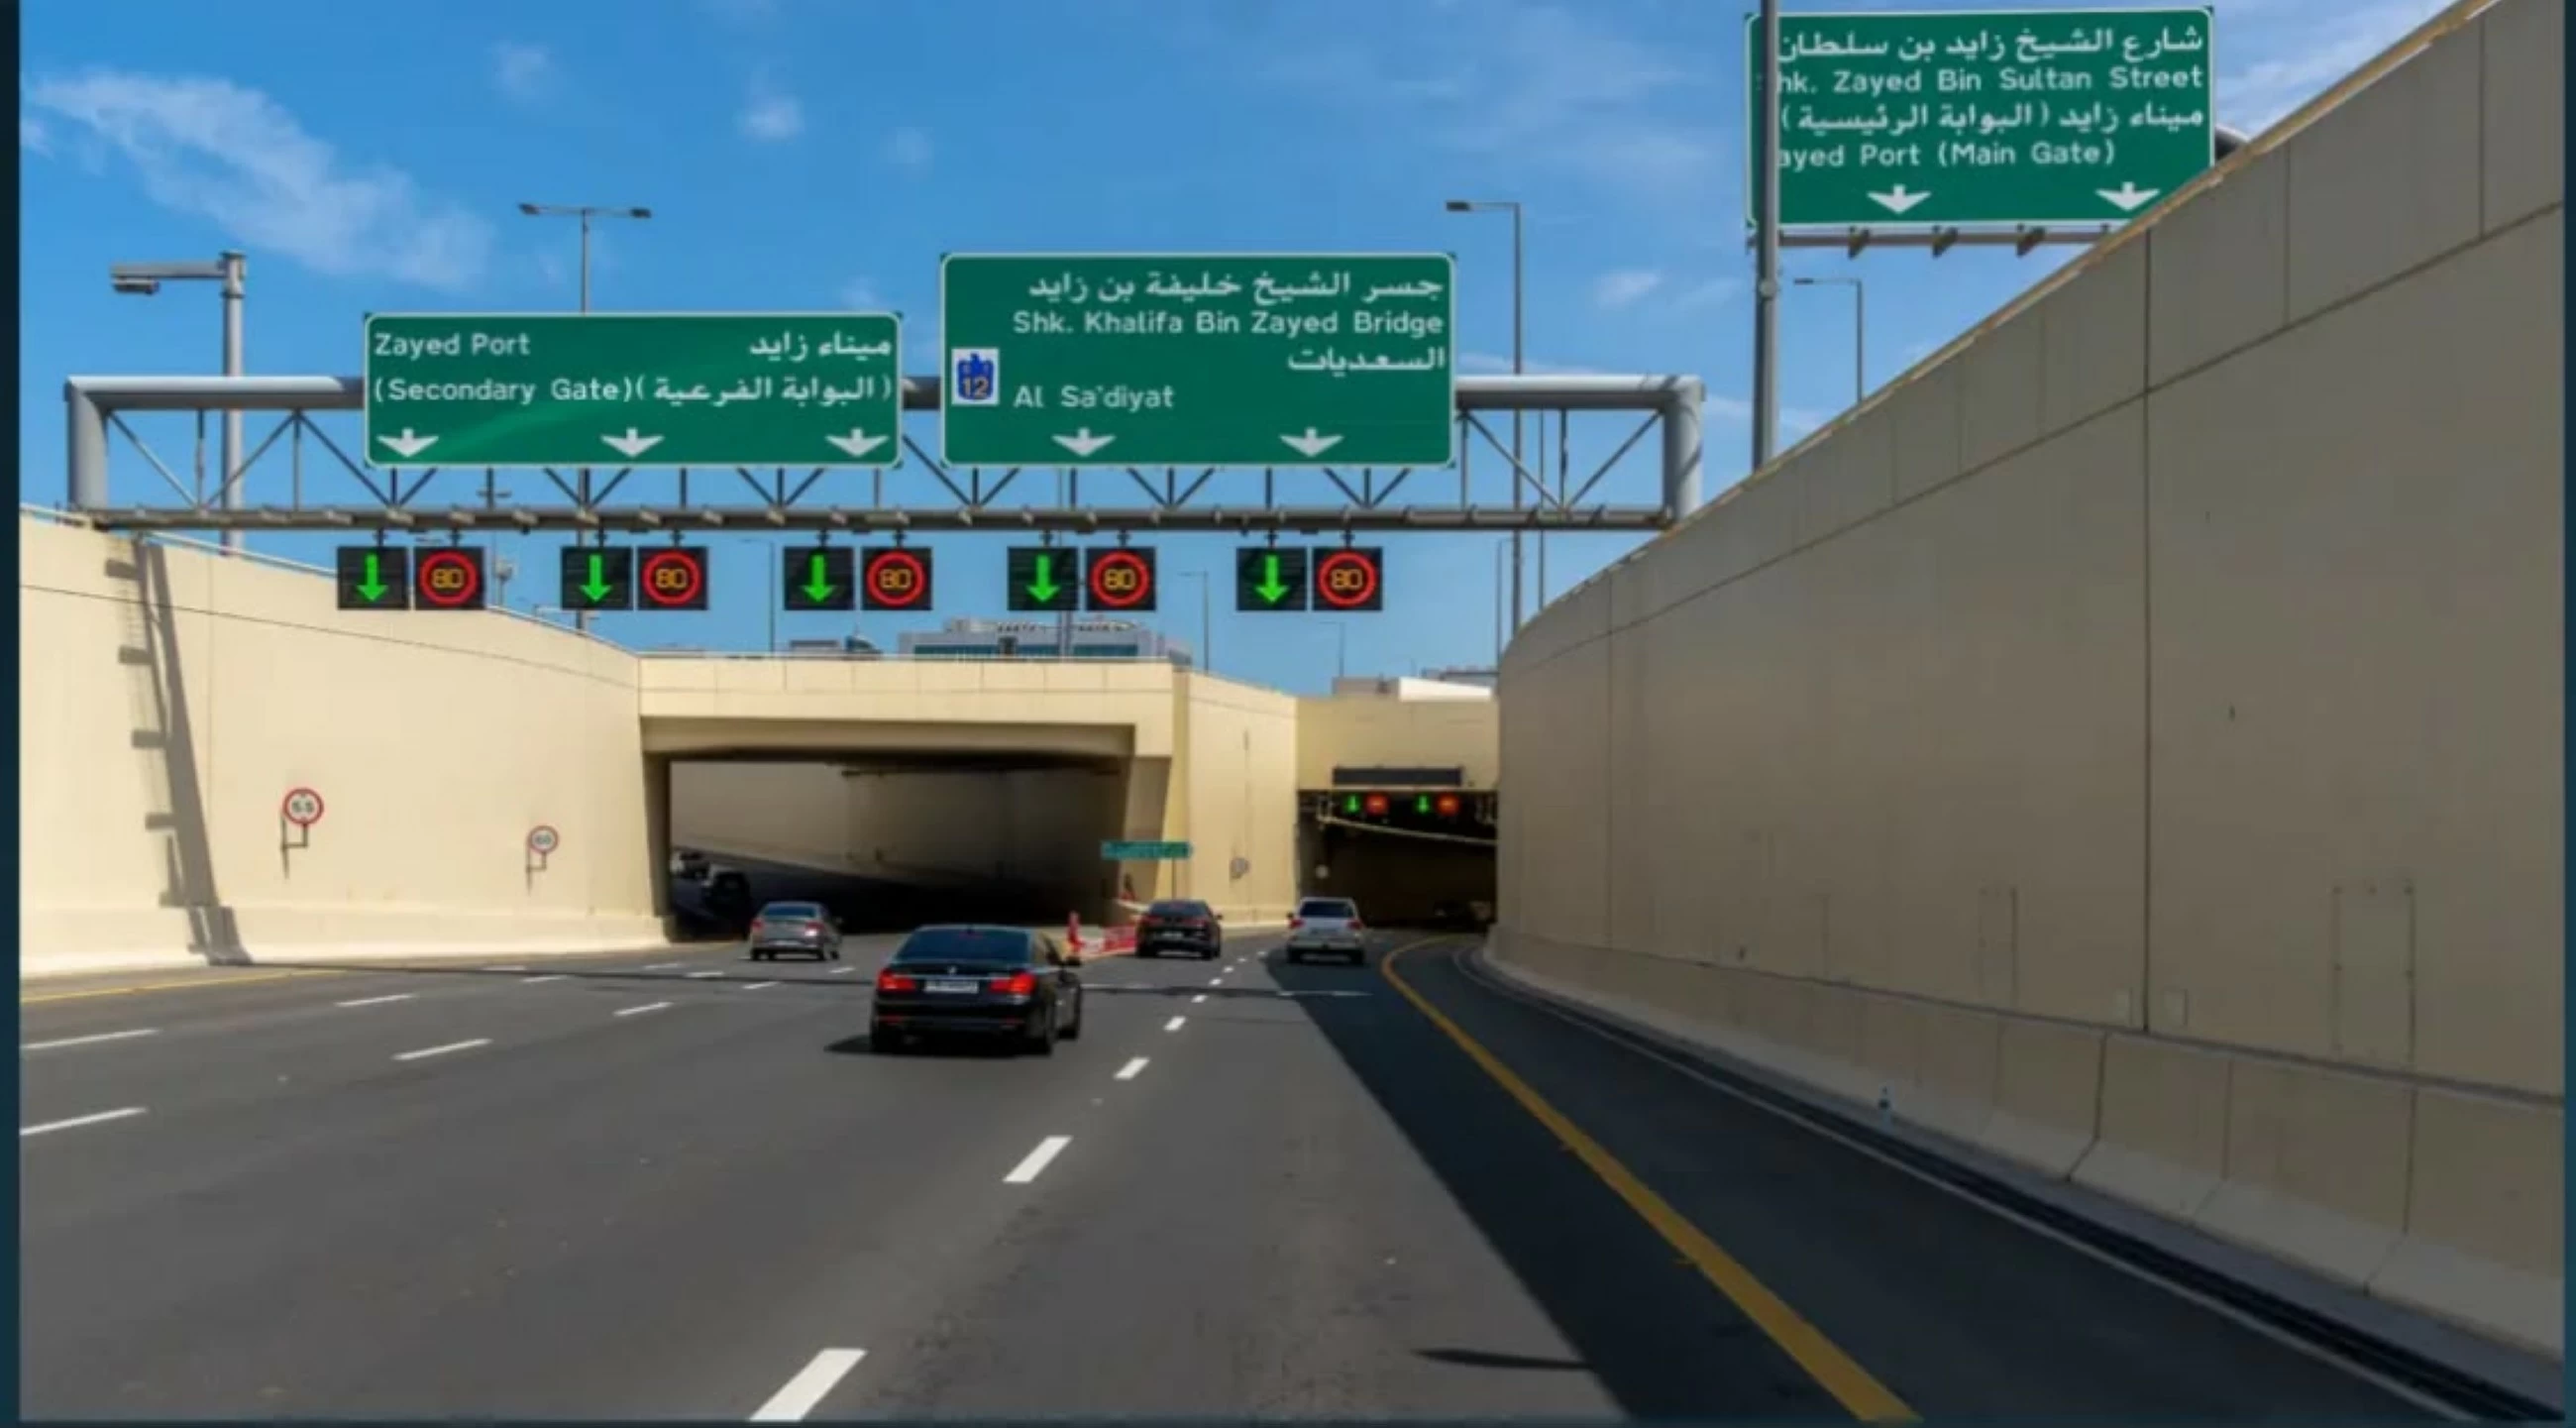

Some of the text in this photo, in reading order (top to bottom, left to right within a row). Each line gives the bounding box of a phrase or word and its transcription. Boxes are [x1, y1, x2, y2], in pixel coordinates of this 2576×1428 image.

[1778, 25, 2203, 63] شارع الشيخ زايد بن سلطان
[1756, 64, 2203, 96] hk. Zayed Bin Sultan Street
[2059, 102, 2119, 134] زايد
[2129, 101, 2204, 133] ميناء
[1777, 139, 2115, 172] ayed Port (Main Gate)
[1028, 272, 1444, 306] جسر الشيخ خليفة بن زايد
[1014, 310, 1444, 338] Shk. Khalifa Bin Zayed Bridge
[375, 331, 530, 360] Zayed Port
[748, 331, 892, 363] ميناء زايد
[1287, 346, 1446, 377] السعديات
[374, 377, 633, 405] (Secondary Gate)
[962, 377, 990, 398] 12
[1014, 384, 1174, 411] Al Sa'diyat
[431, 568, 464, 589] 80
[655, 568, 688, 589] 80
[880, 569, 912, 589] 80
[1104, 568, 1134, 589] 80
[1332, 570, 1361, 589] 80
